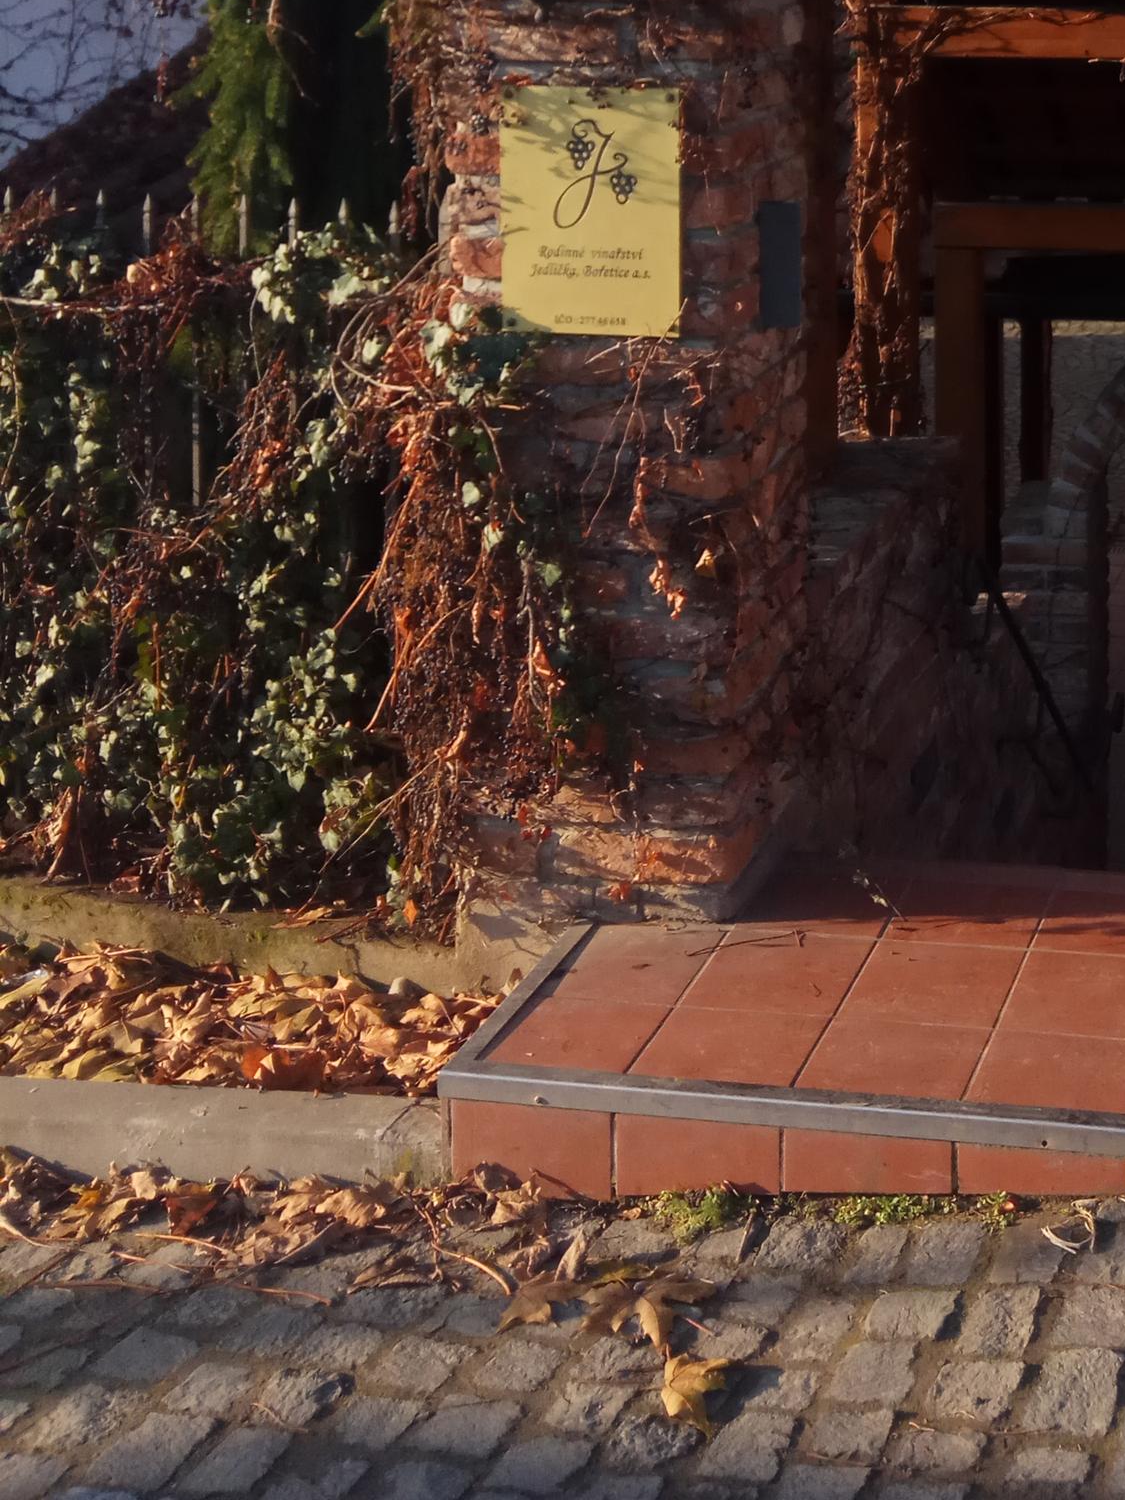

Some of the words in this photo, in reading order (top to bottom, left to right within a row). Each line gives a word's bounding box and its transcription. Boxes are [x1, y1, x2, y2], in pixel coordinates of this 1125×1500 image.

[537, 244, 585, 259] Rodinné
[591, 246, 644, 260] vinařství
[582, 264, 630, 278] Bořetice
[632, 269, 652, 280] a.s.
